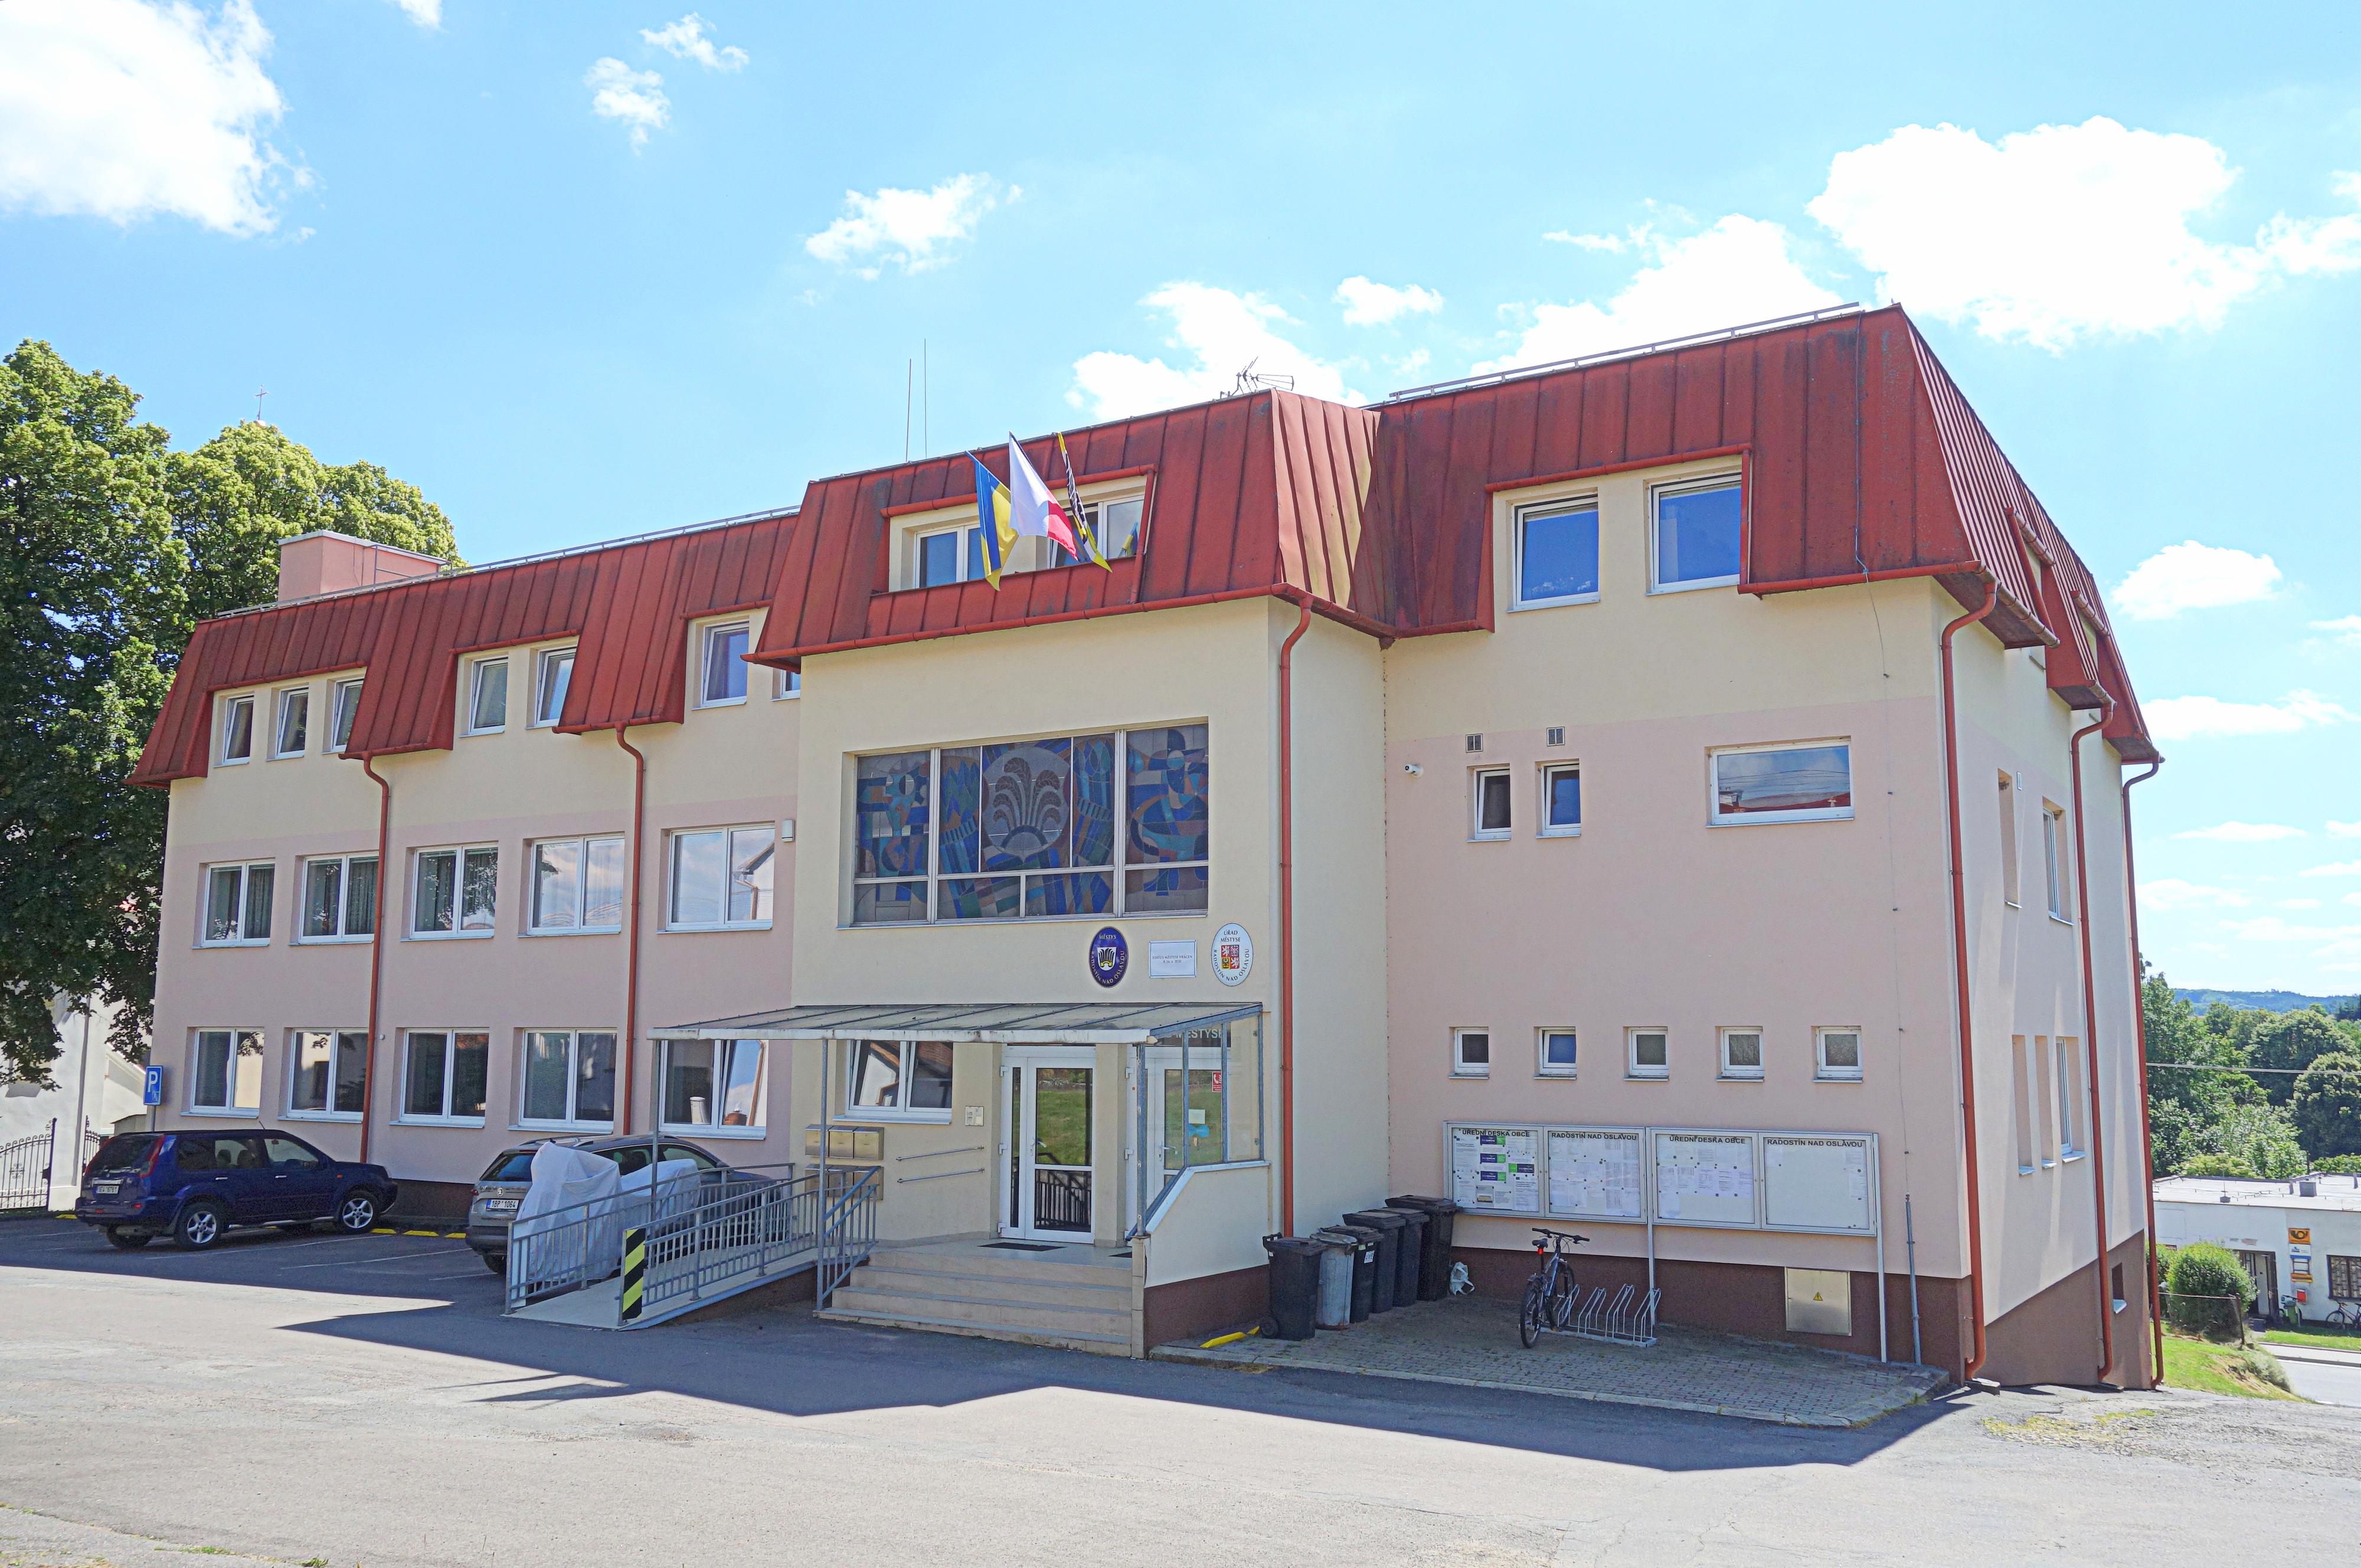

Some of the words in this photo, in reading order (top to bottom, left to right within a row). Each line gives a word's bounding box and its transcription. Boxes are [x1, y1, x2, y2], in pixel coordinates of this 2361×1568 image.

[1114, 951, 1125, 979] OSLAVOU
[1213, 949, 1225, 978] RADOSTÍN
[1238, 948, 1250, 977] OSLAVOU
[147, 1071, 158, 1092] P
